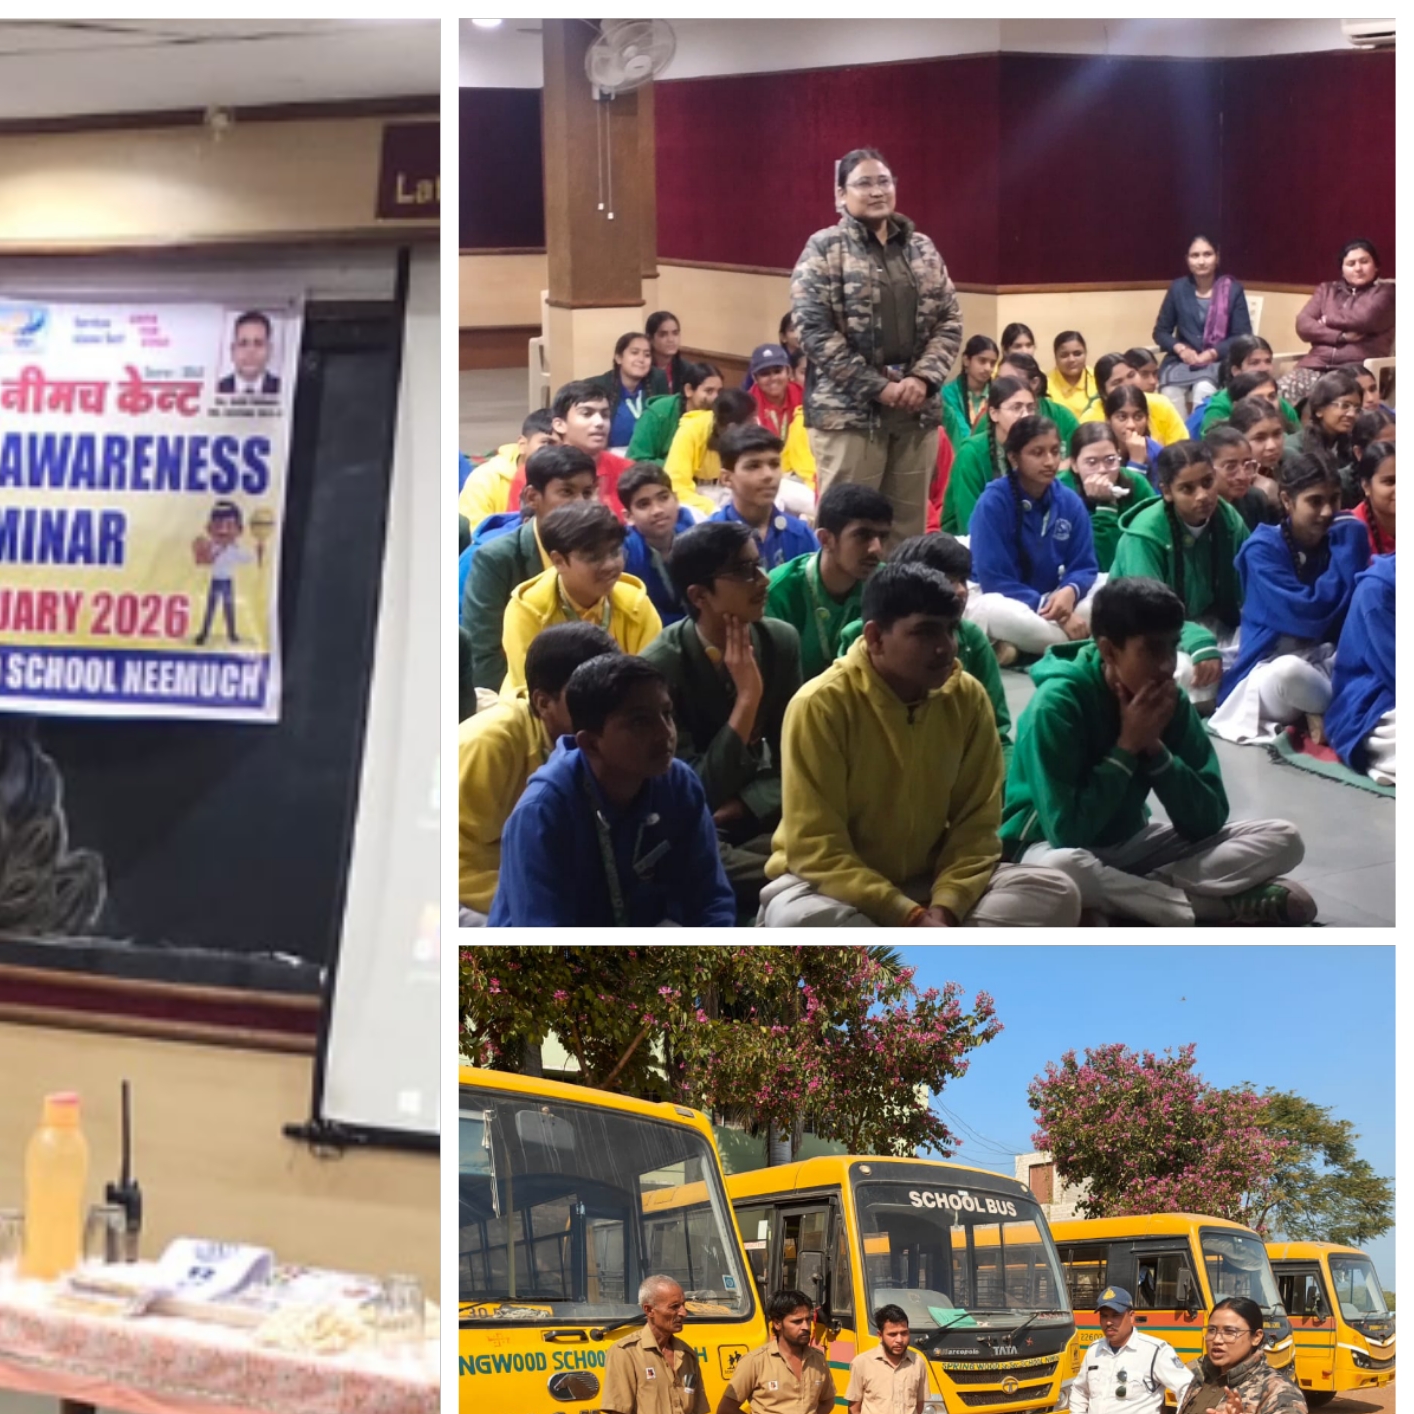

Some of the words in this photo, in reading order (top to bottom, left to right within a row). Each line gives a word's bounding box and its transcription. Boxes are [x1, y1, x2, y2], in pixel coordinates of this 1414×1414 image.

[397, 171, 440, 204] La
[0, 364, 110, 415] नीमच
[90, 591, 190, 639] 2026
[6, 652, 116, 693] SCHOOL
[122, 658, 263, 699] NEEMUCH
[908, 1189, 986, 1214] SCHOOL
[985, 1198, 1017, 1218] BUS
[552, 1349, 607, 1370] SCHOO
[992, 1346, 1018, 1356] TATA
